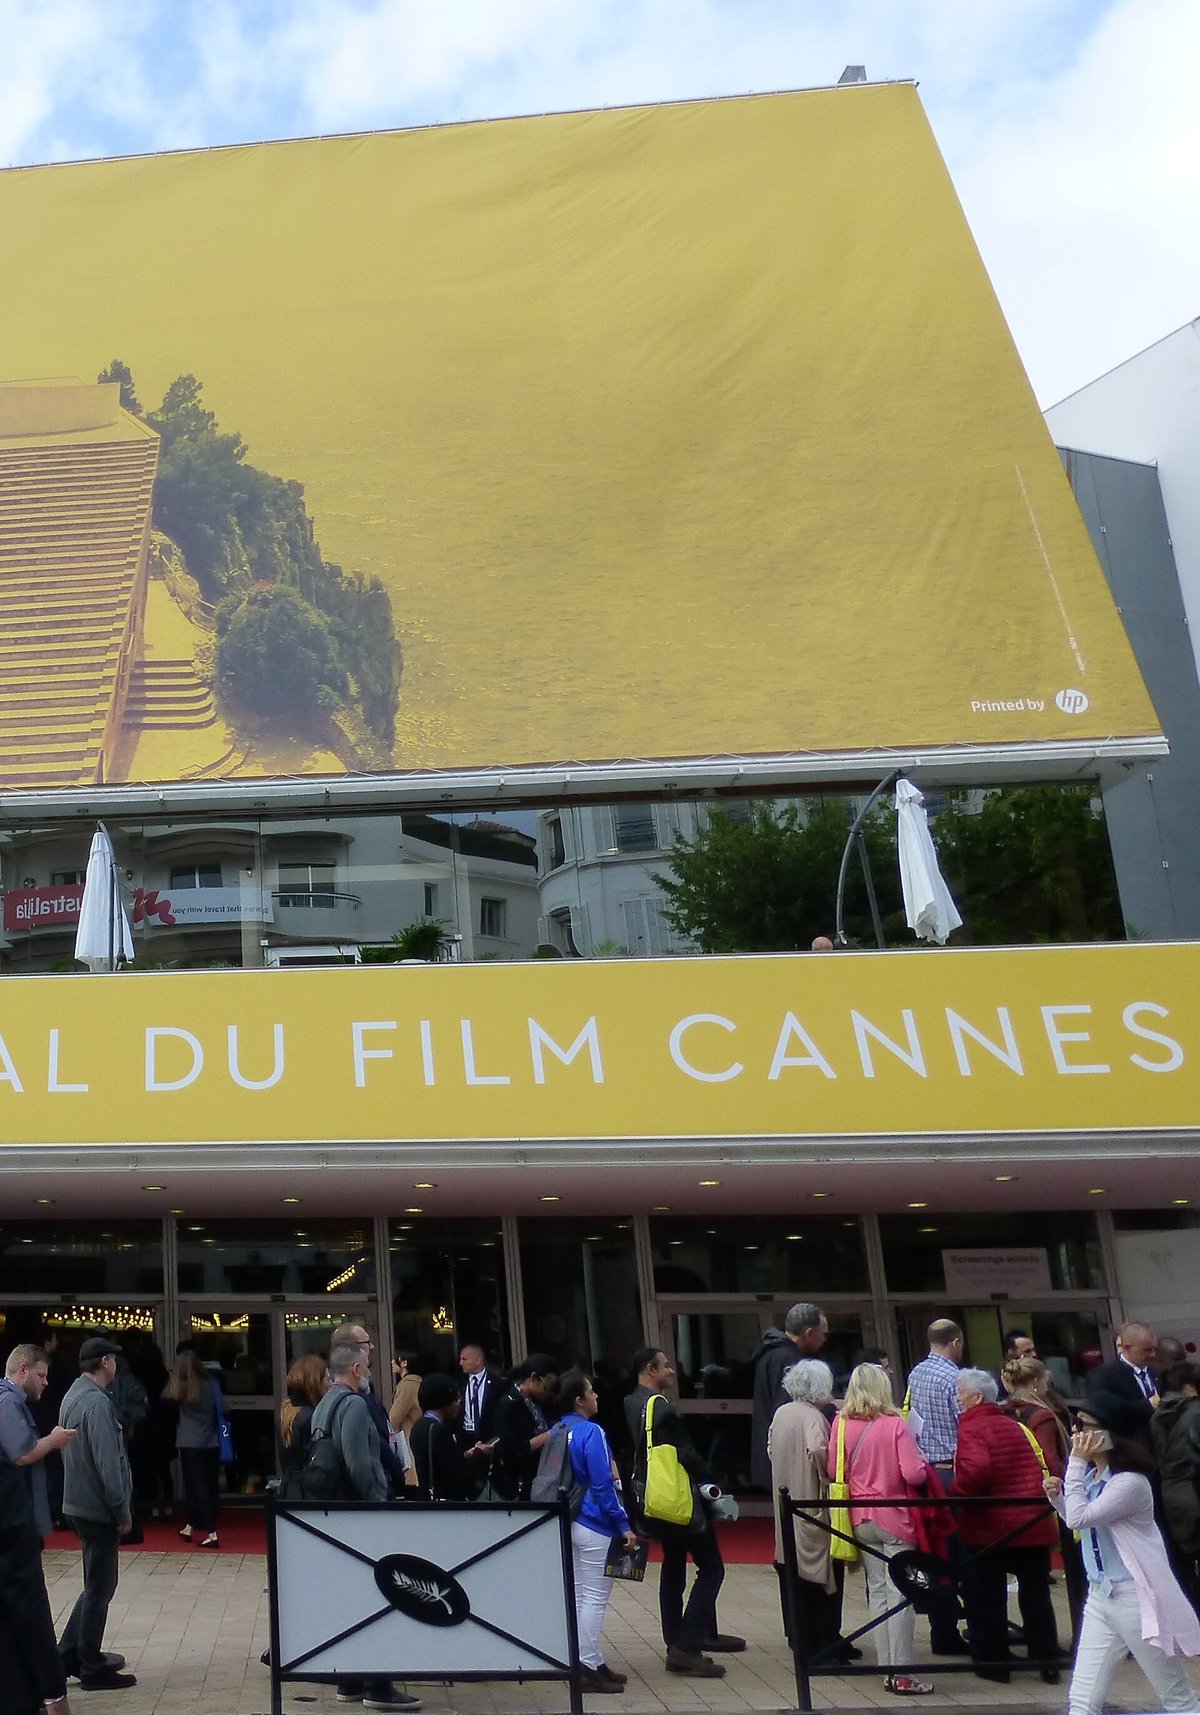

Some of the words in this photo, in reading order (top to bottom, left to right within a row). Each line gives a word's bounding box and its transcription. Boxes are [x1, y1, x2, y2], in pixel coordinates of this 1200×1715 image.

[971, 699, 1025, 712] Printed
[1026, 698, 1045, 712] by
[1059, 689, 1085, 713] hp
[145, 1023, 285, 1091] DU
[352, 1017, 605, 1087] FILM
[669, 1002, 1184, 1083] CANNES
